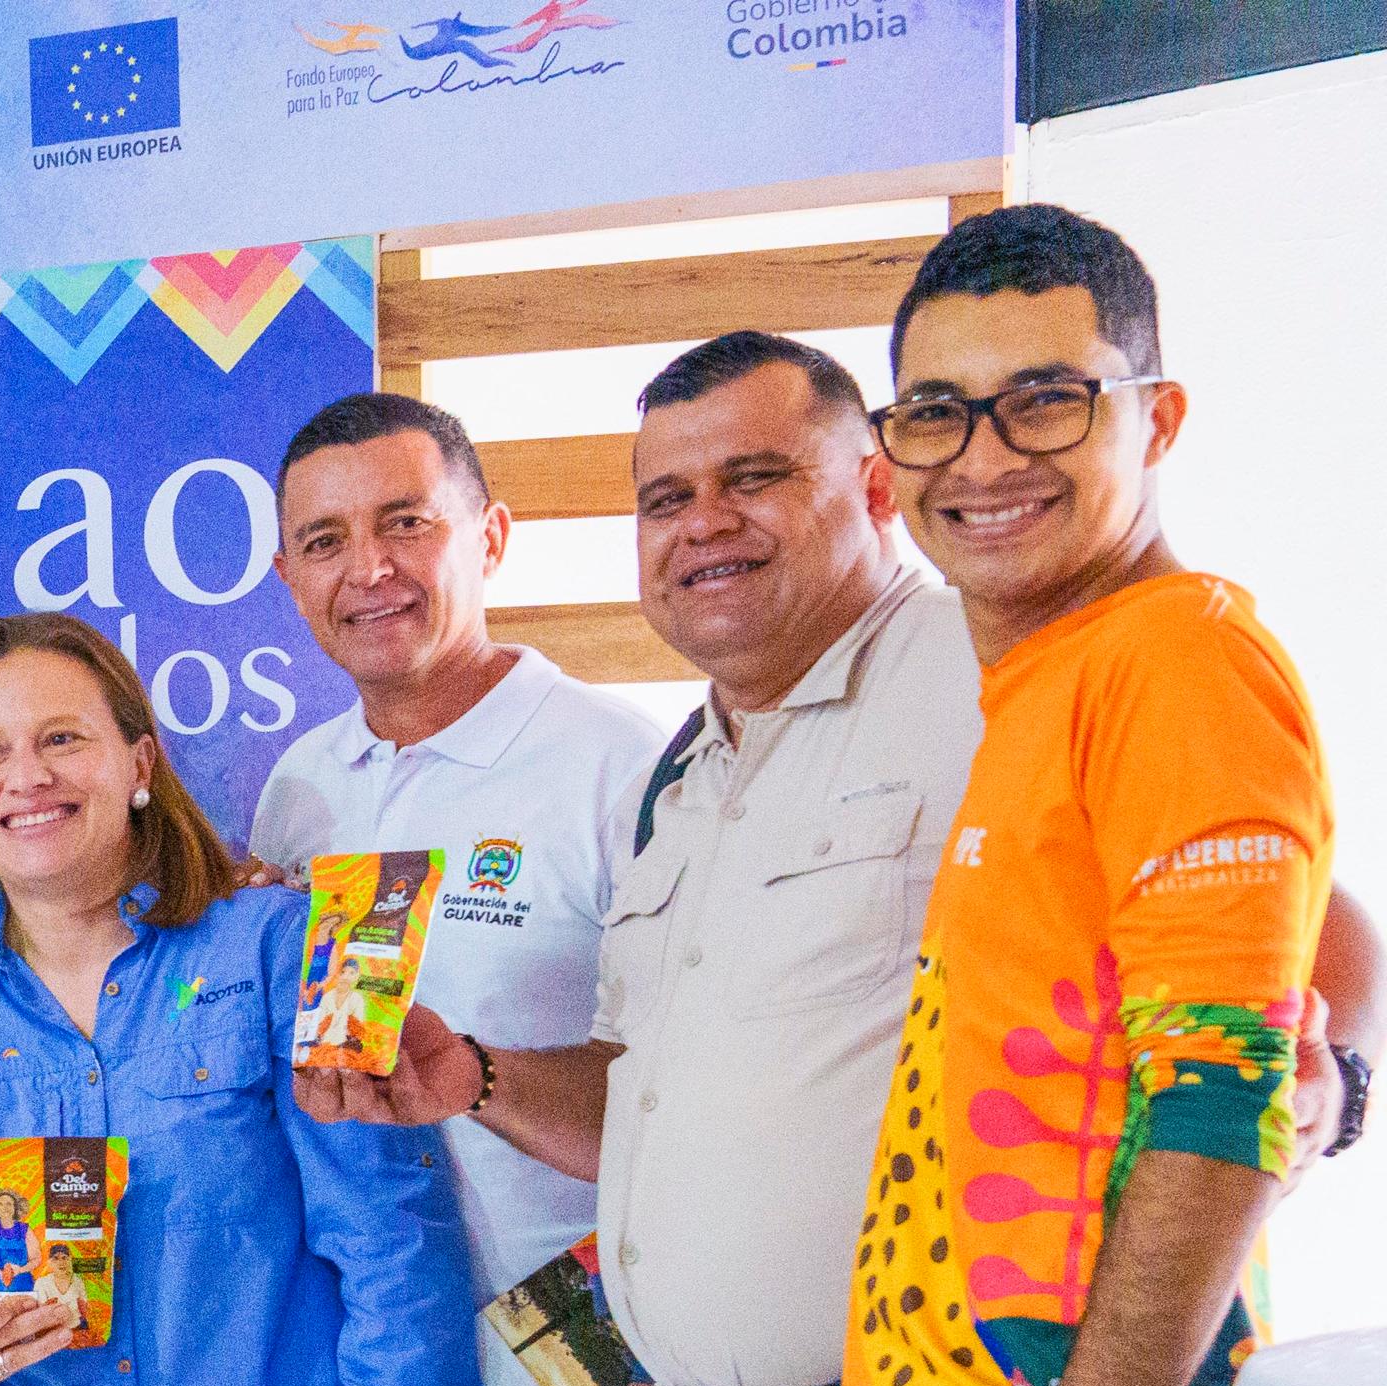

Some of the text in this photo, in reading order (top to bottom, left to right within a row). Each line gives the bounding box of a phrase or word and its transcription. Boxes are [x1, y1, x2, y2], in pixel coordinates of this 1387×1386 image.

[727, 9, 908, 60] Colombia
[286, 64, 375, 88] Fondo Europeo
[287, 88, 360, 118] para la Paz
[33, 135, 183, 170] UNIÓN EUROPEA
[514, 900, 532, 913] del
[443, 908, 525, 928] GUAVIARE
[50, 1182, 100, 1194] Campo
[62, 1172, 88, 1184] Del
